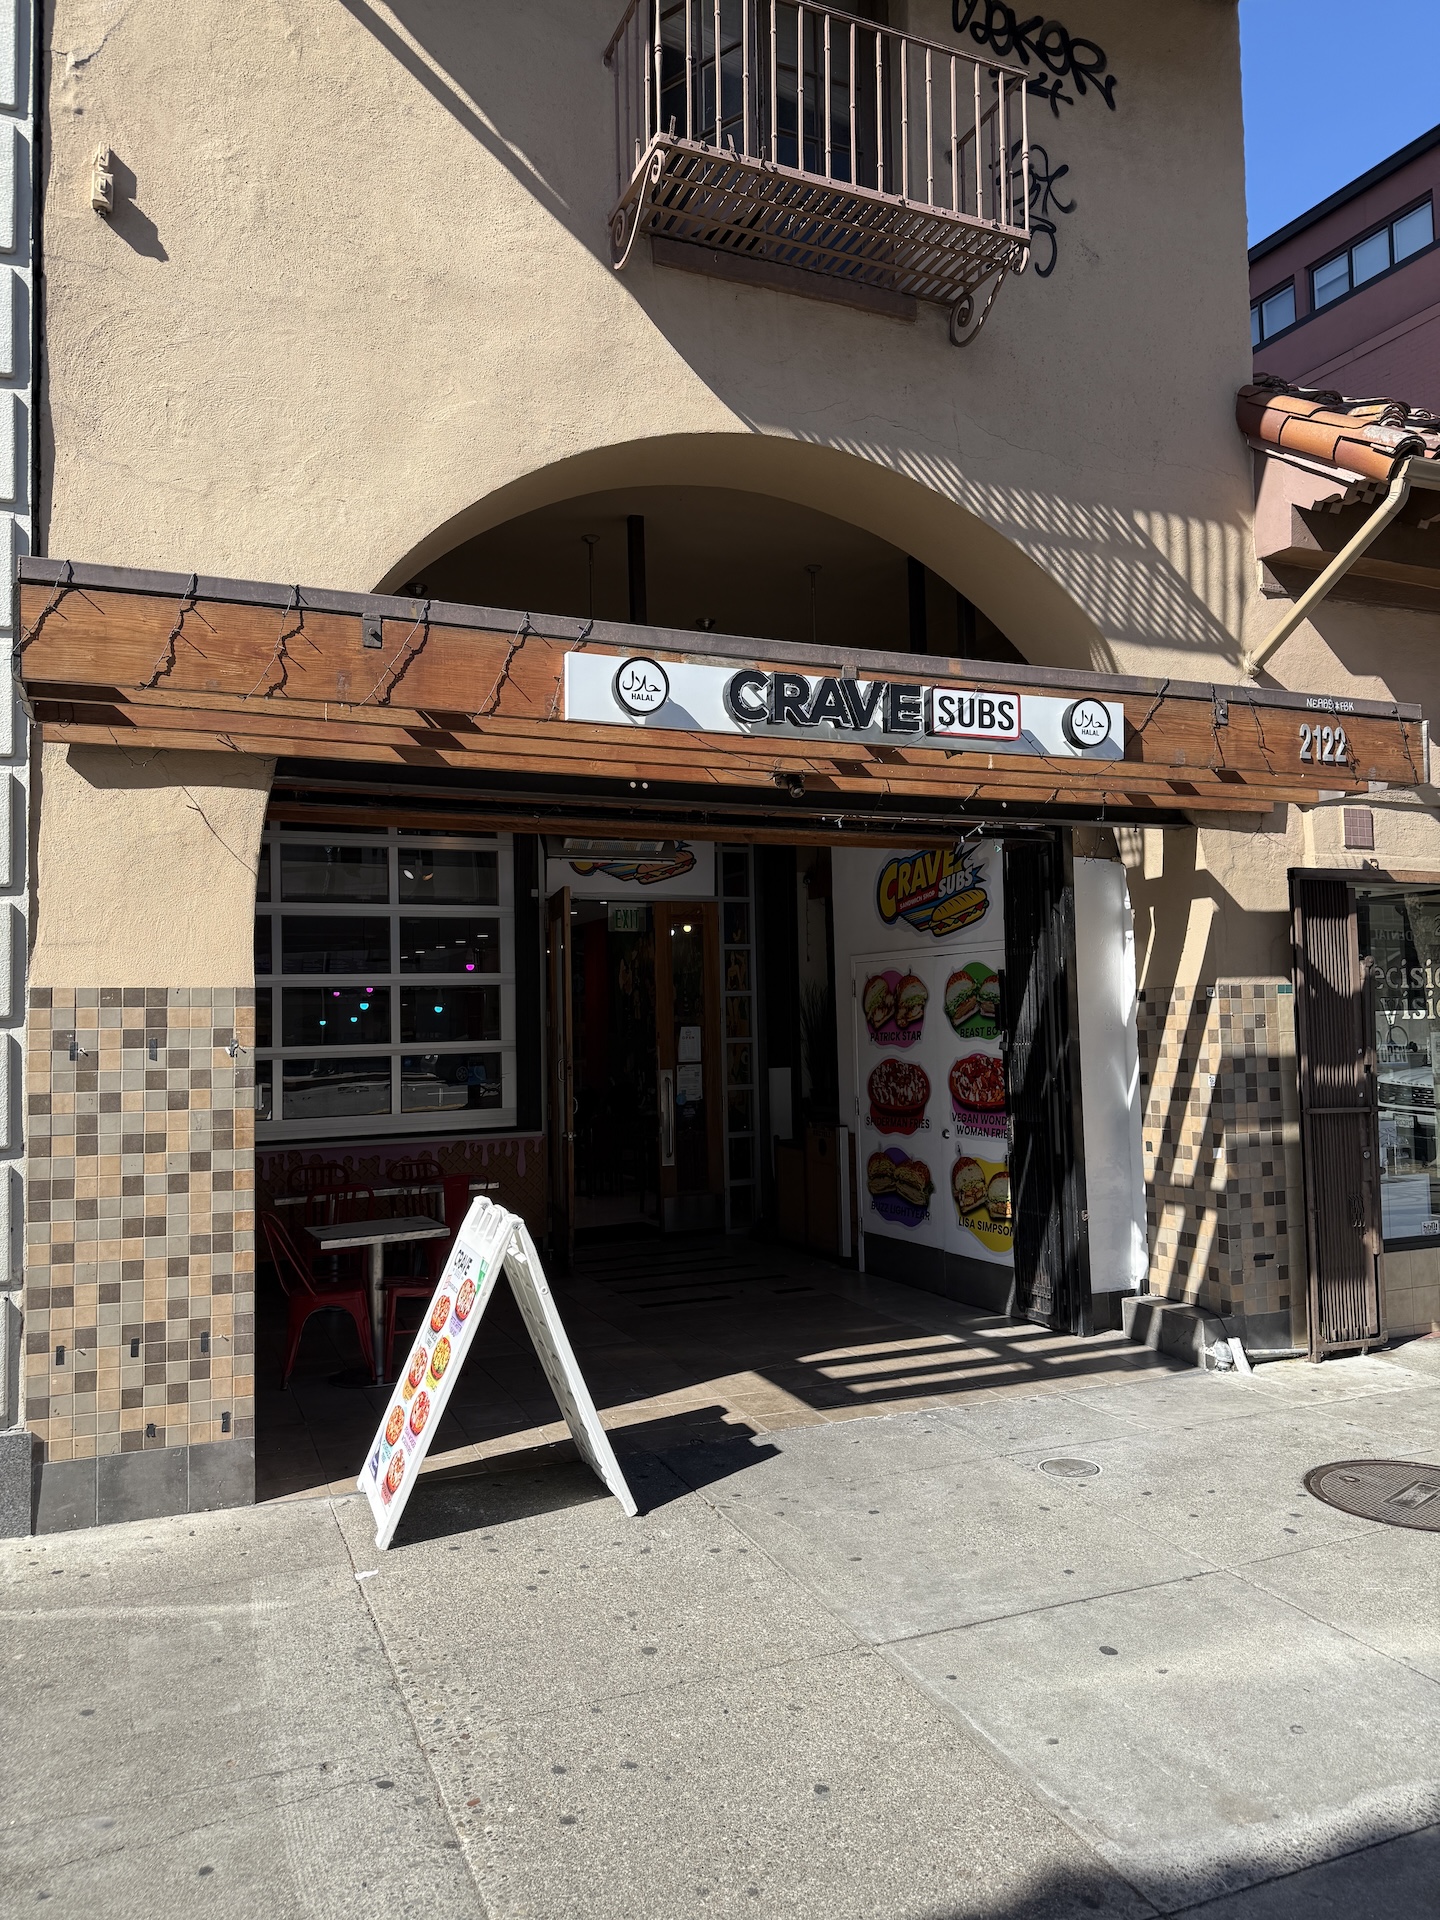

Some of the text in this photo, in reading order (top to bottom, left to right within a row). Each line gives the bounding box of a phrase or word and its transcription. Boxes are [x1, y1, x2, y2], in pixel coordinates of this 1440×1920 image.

[622, 670, 661, 692] حلال
[631, 693, 655, 701] HALAL
[726, 668, 1015, 733] CRAVE SUBS
[1075, 709, 1105, 728] حلال
[1299, 723, 1347, 762] 2122
[880, 850, 956, 917] CRAVE
[938, 865, 973, 898] SUBS
[899, 890, 936, 910] SANDWICH SHOP
[615, 909, 640, 929] EXIT
[1374, 958, 1440, 990] ecisi
[1379, 990, 1440, 1025] visi
[870, 1031, 922, 1042] PATRICK STAR
[960, 1026, 998, 1038] BEAST BO
[865, 1116, 930, 1129] SPIDERMAN FRIES
[952, 1112, 1007, 1126] VEGAN WOND
[956, 1124, 1008, 1139] WOMAN FRIE
[871, 1201, 930, 1221] BUZZ LIGHTYEAR
[958, 1217, 975, 1229] LISA
